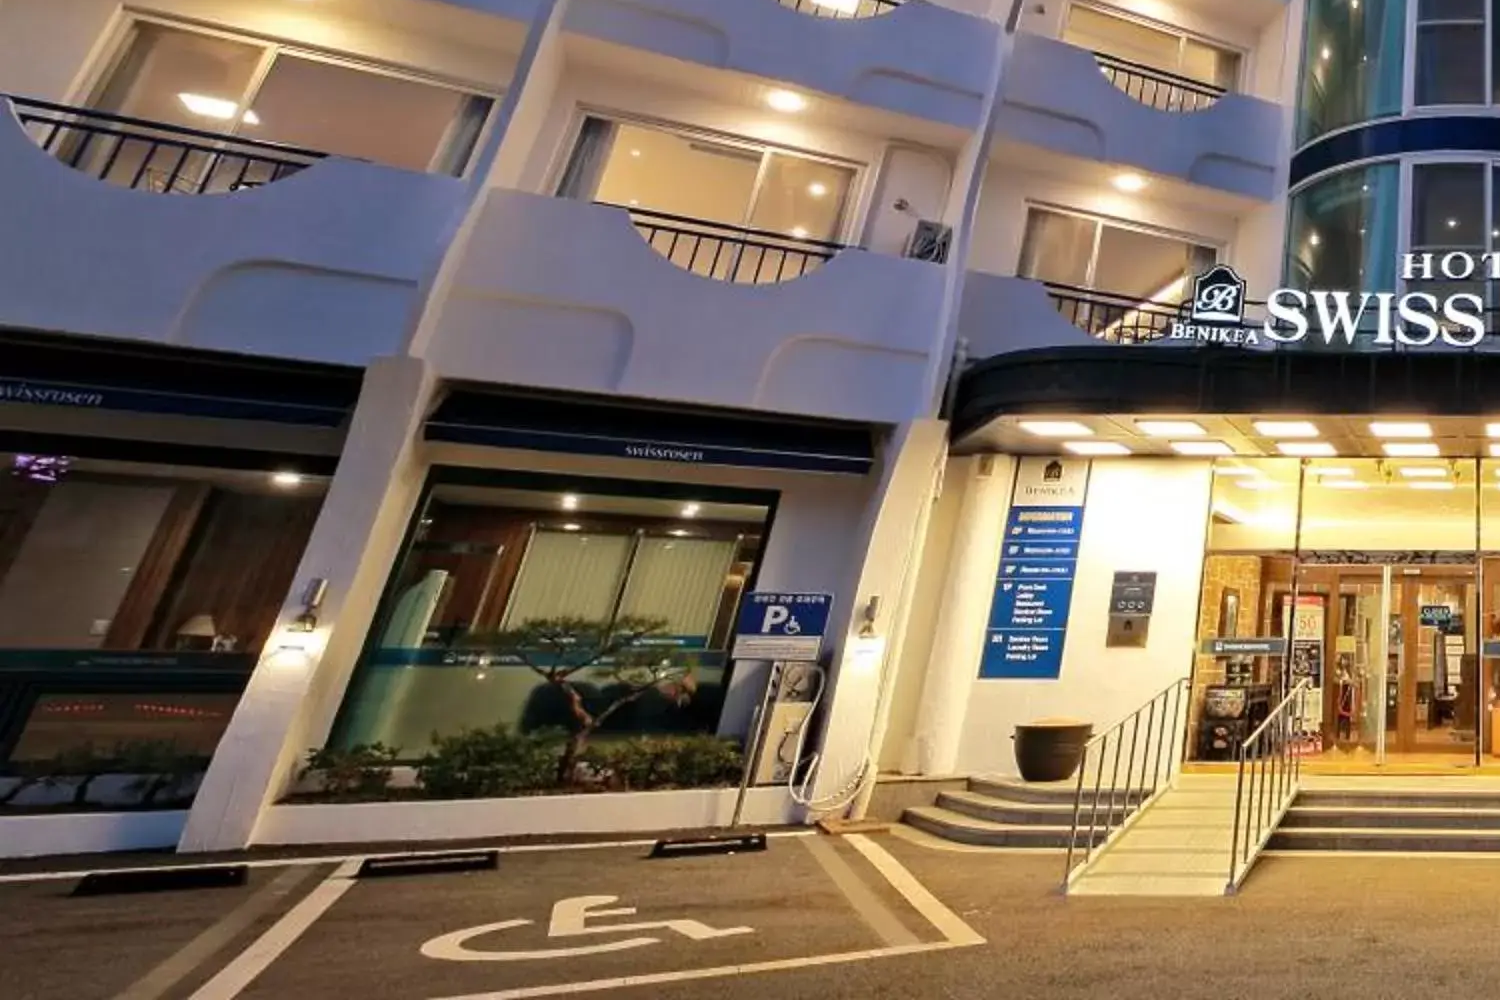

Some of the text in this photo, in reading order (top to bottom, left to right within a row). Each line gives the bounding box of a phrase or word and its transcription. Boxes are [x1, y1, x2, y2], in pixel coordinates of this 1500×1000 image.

[1263, 288, 1486, 346] SWISS
[1169, 323, 1260, 345] BENIKEA
[625, 444, 704, 461] swissrosen
[761, 605, 790, 633] P
